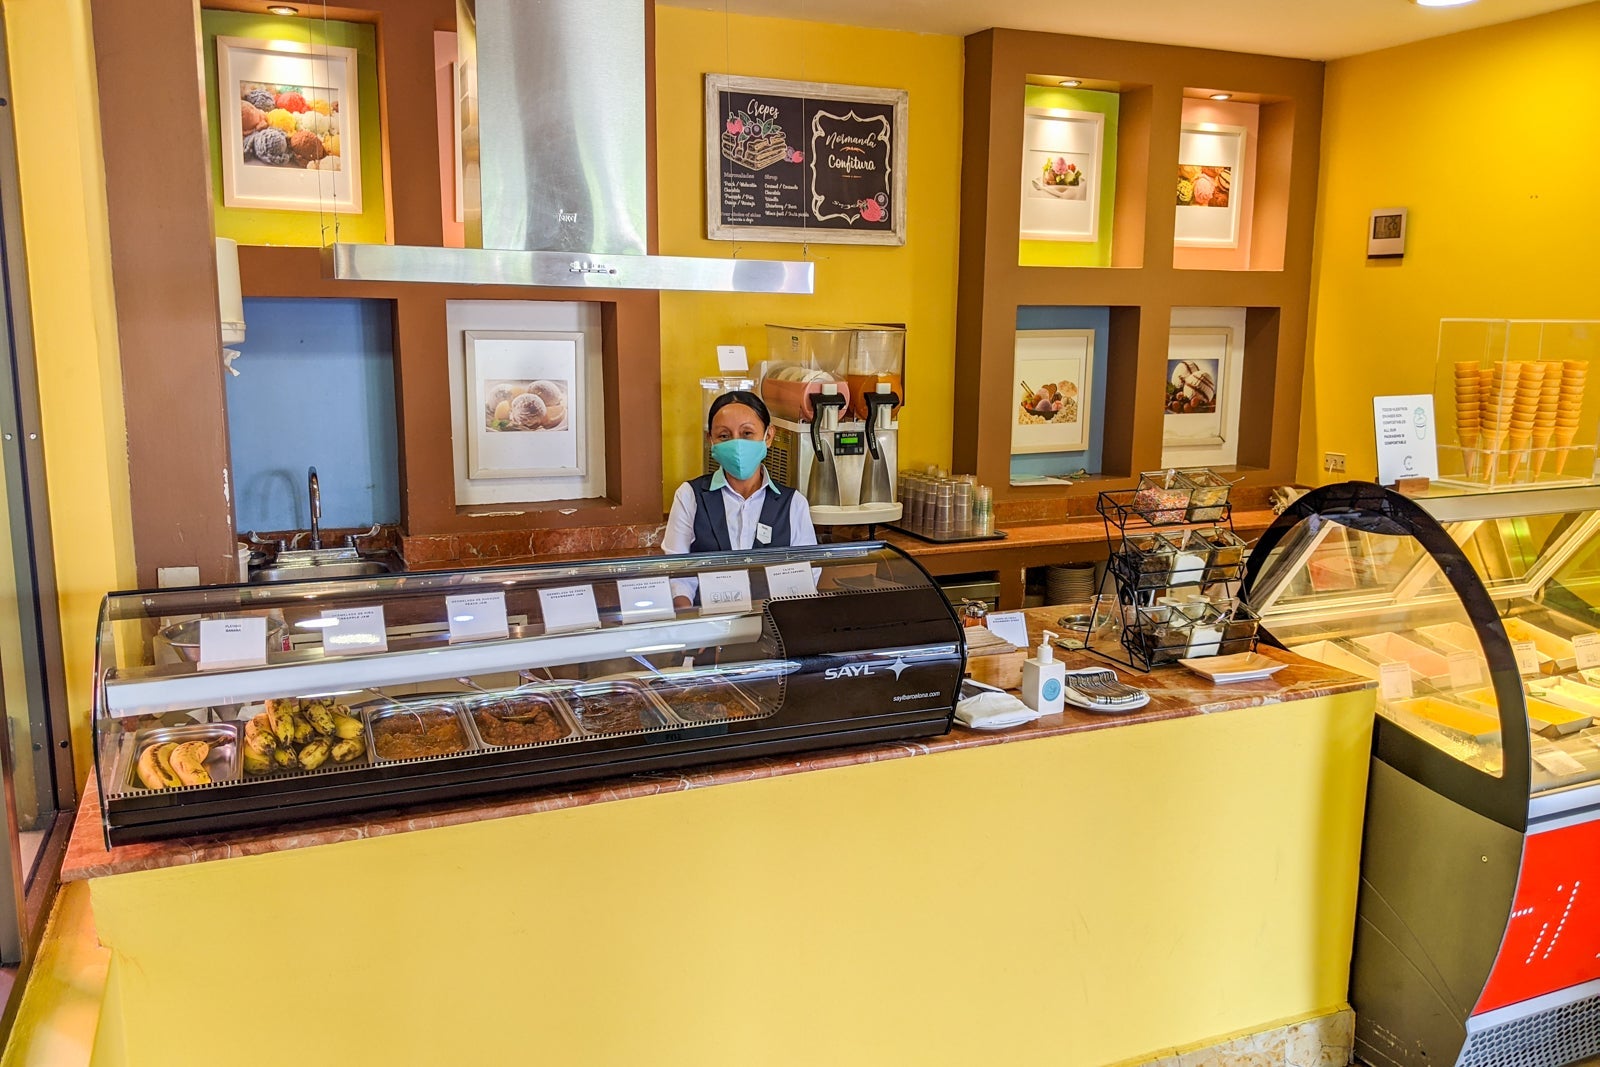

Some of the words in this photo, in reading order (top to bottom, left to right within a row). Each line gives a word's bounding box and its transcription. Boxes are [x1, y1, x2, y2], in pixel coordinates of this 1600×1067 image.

[747, 98, 780, 120] Crepes
[826, 132, 877, 149] Normanda
[828, 154, 876, 173] Confitura
[824, 664, 875, 680] SAYL
[892, 691, 941, 703] saylbarcelona.com
